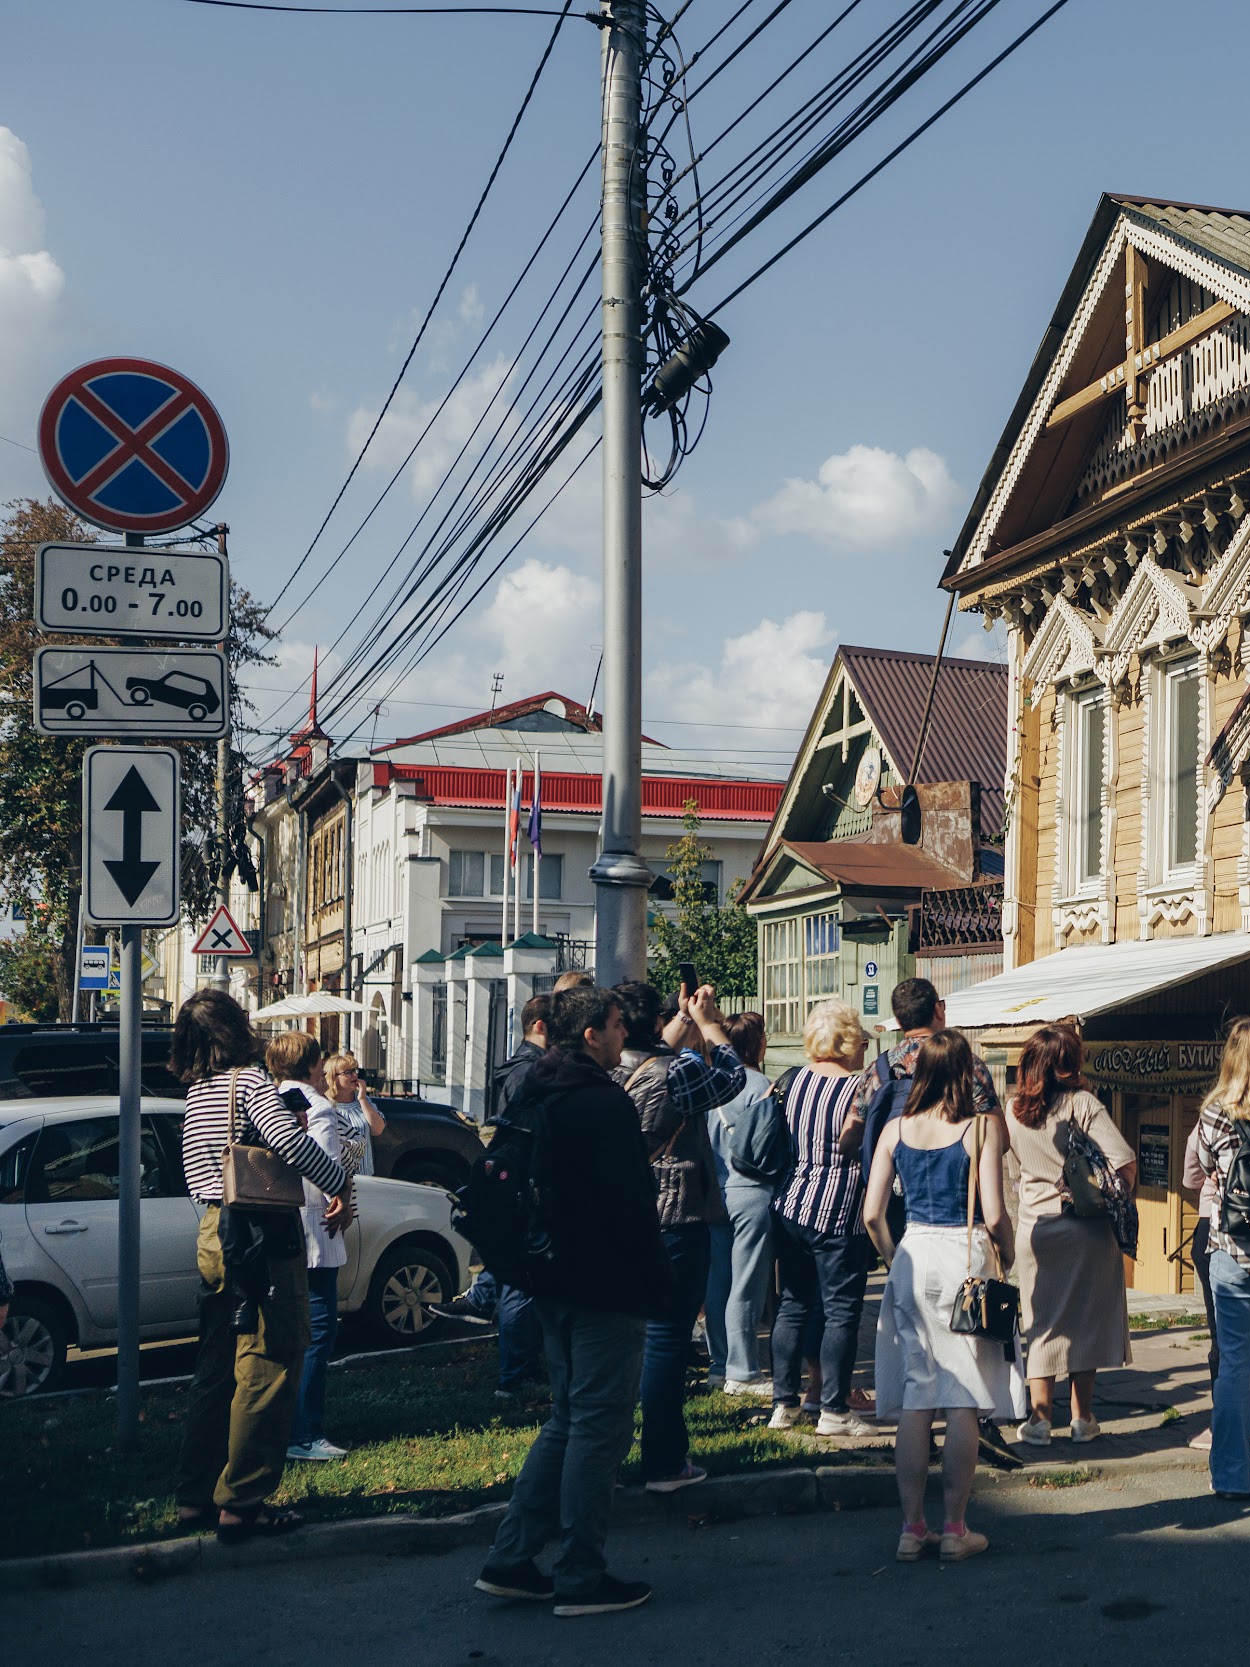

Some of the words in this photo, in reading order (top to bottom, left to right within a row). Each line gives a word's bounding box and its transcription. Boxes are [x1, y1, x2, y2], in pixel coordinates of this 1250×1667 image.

[89, 564, 176, 589] СРЕДА
[61, 587, 117, 613] 0.00
[148, 592, 203, 618] 7.00
[1178, 1045, 1224, 1069] БУТИЧ
